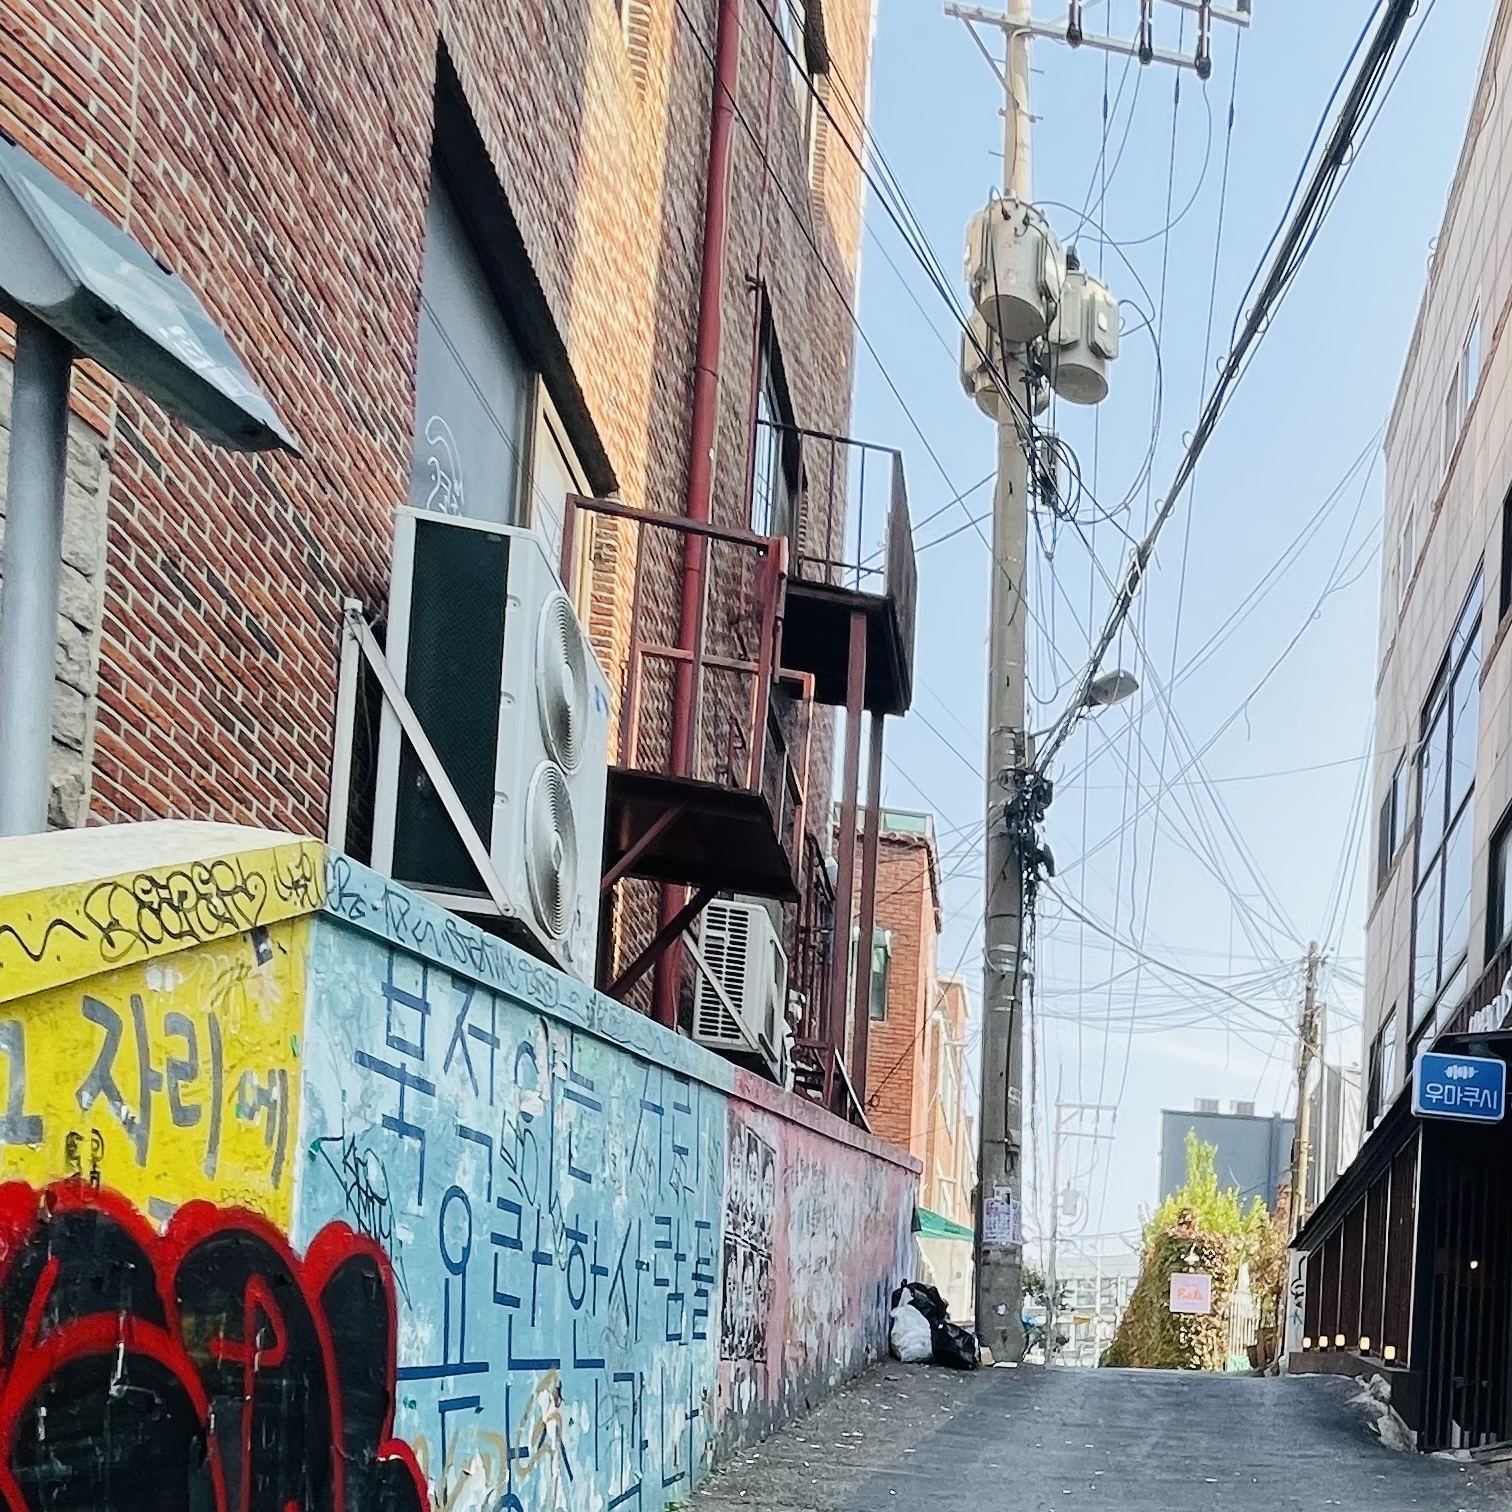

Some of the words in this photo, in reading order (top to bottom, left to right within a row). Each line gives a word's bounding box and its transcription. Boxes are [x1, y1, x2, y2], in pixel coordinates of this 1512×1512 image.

[76, 993, 289, 1188] 자리에
[1425, 1082, 1497, 1110] 우마쿠시
[397, 1185, 609, 1382] 요란한
[608, 1216, 715, 1345] 사람들
